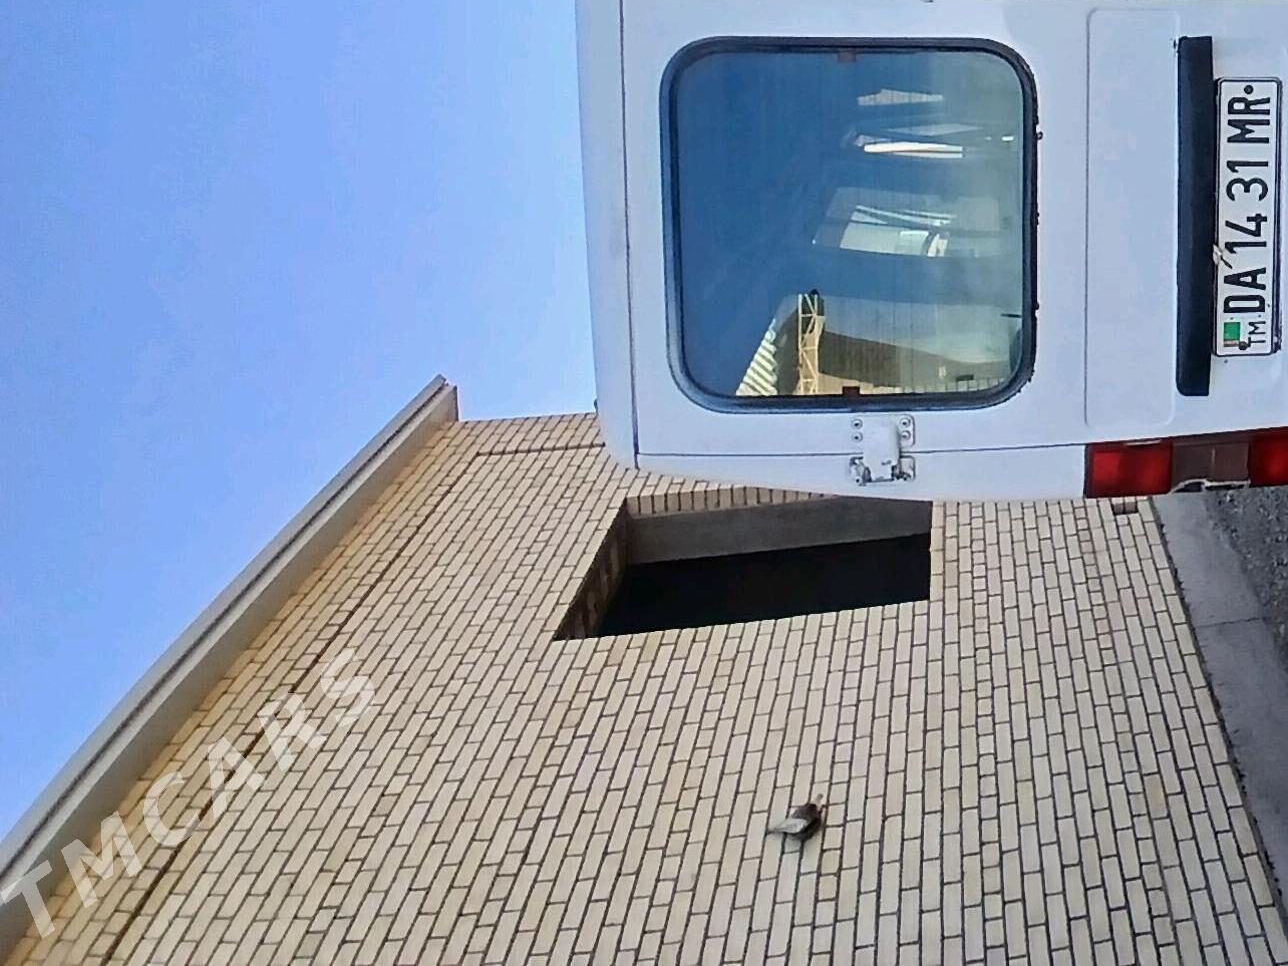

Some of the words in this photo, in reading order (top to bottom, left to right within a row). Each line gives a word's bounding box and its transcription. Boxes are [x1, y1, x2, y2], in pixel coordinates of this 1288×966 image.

[1227, 97, 1270, 144] MR
[1226, 160, 1270, 201] 31
[1225, 213, 1268, 255] 14
[1224, 267, 1266, 314] DA
[1248, 321, 1266, 345] TM
